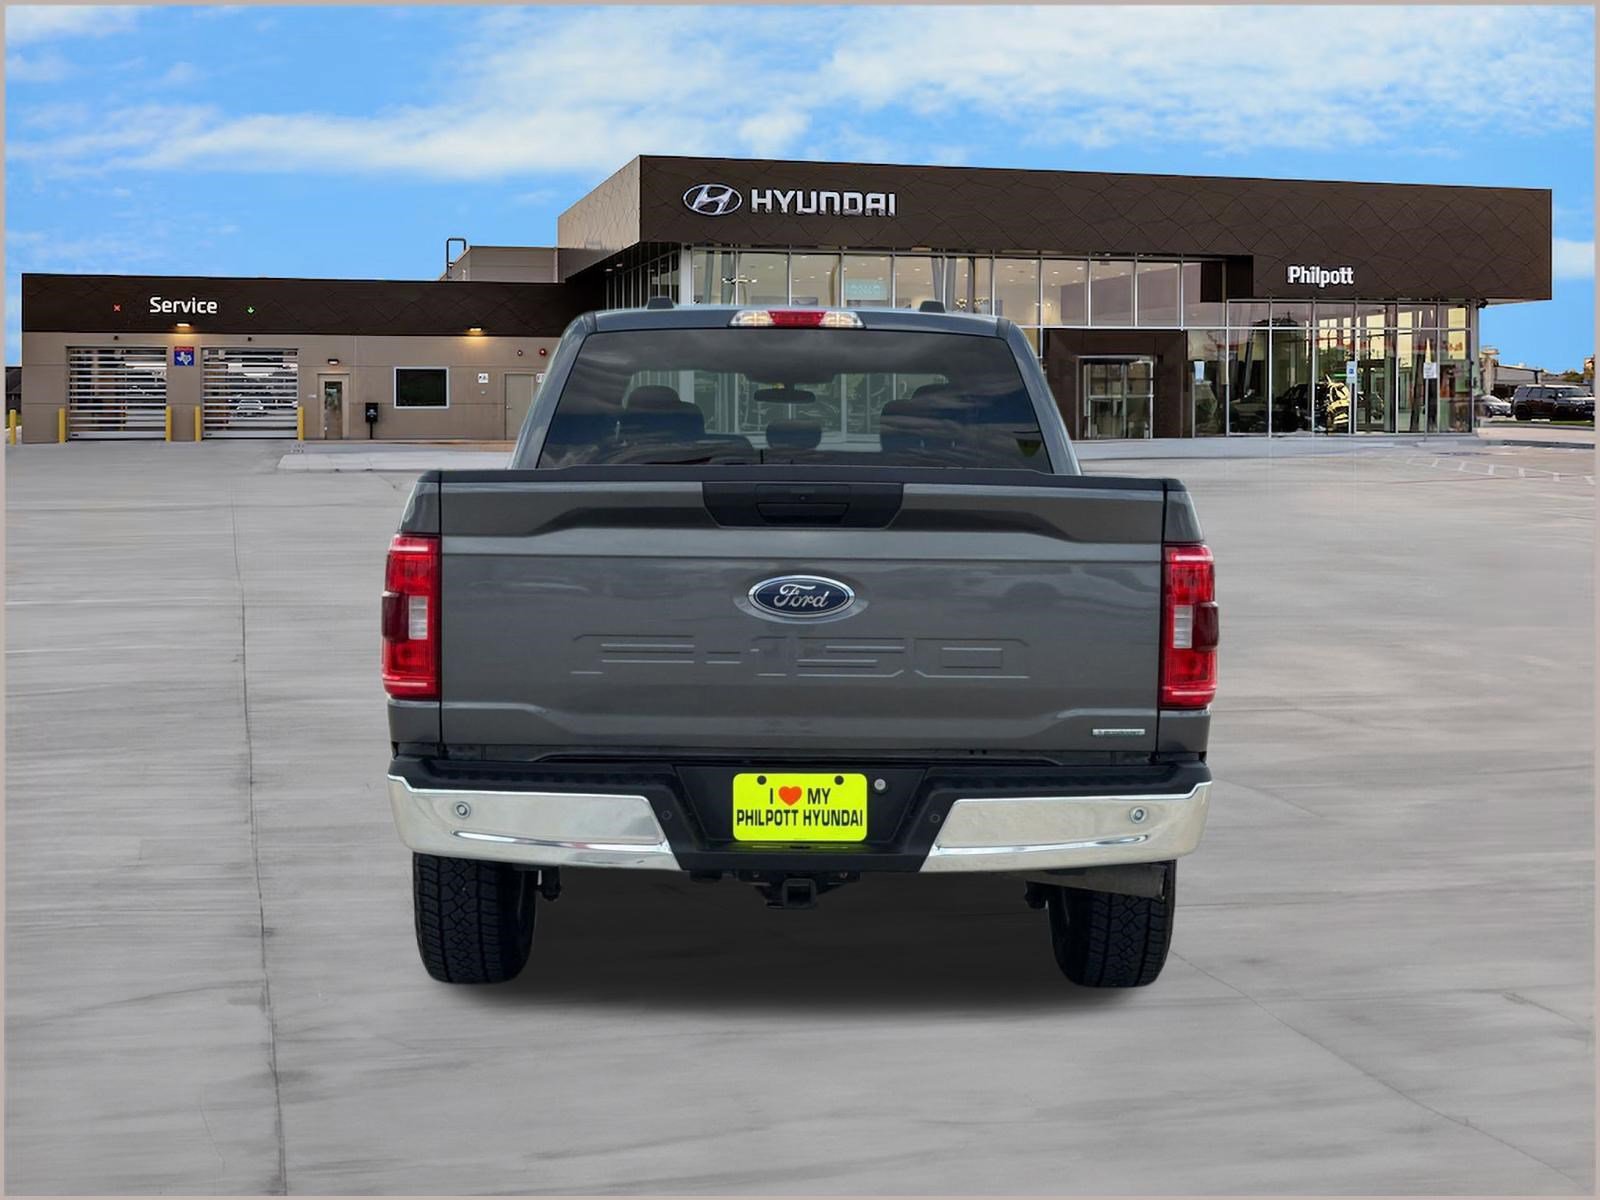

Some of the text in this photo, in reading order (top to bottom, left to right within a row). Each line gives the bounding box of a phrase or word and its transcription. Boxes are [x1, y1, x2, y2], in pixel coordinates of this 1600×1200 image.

[751, 189, 896, 217] HYUNDAI
[1287, 265, 1354, 288] Philpott
[149, 296, 218, 314] Service
[773, 583, 830, 608] Ford
[571, 634, 1030, 679] F-150
[769, 788, 831, 805] I MY
[736, 809, 863, 826] PHILPOTT HYUNDAI
